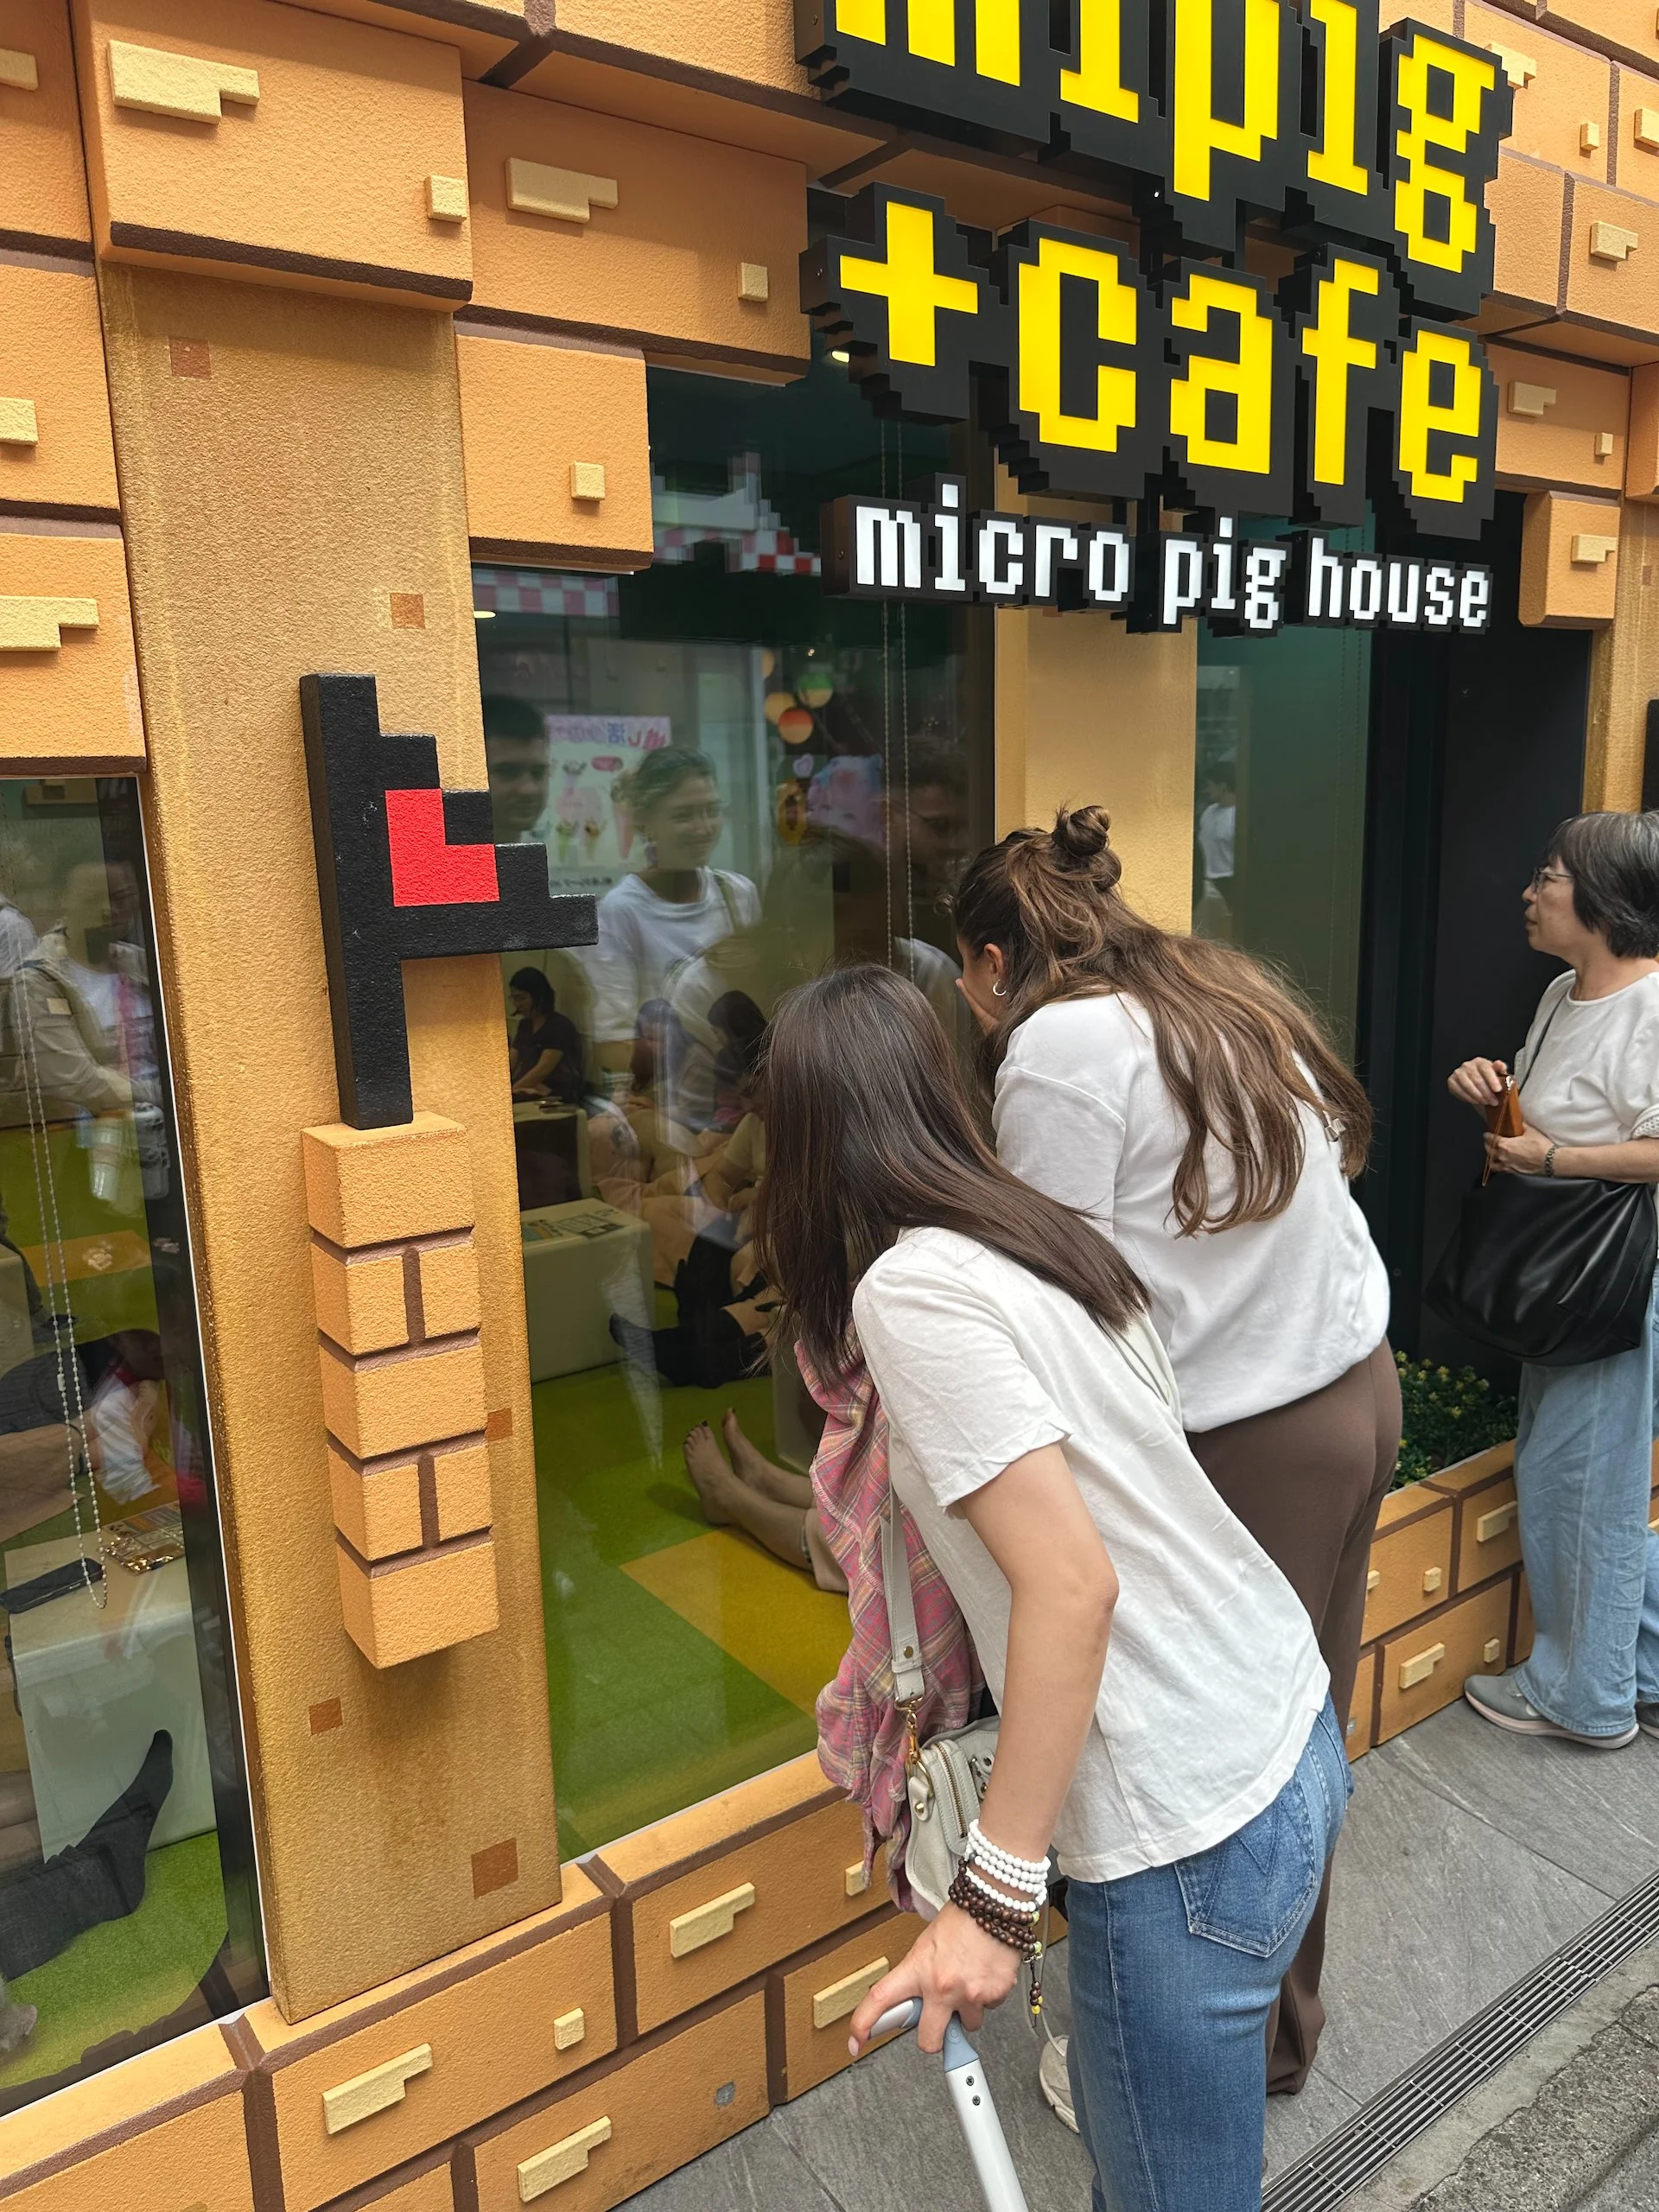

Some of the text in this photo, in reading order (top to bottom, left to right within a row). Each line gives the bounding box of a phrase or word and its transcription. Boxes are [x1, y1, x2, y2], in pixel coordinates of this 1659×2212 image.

[836, 0, 1495, 274] pig
[856, 484, 1490, 630] micro pig house
